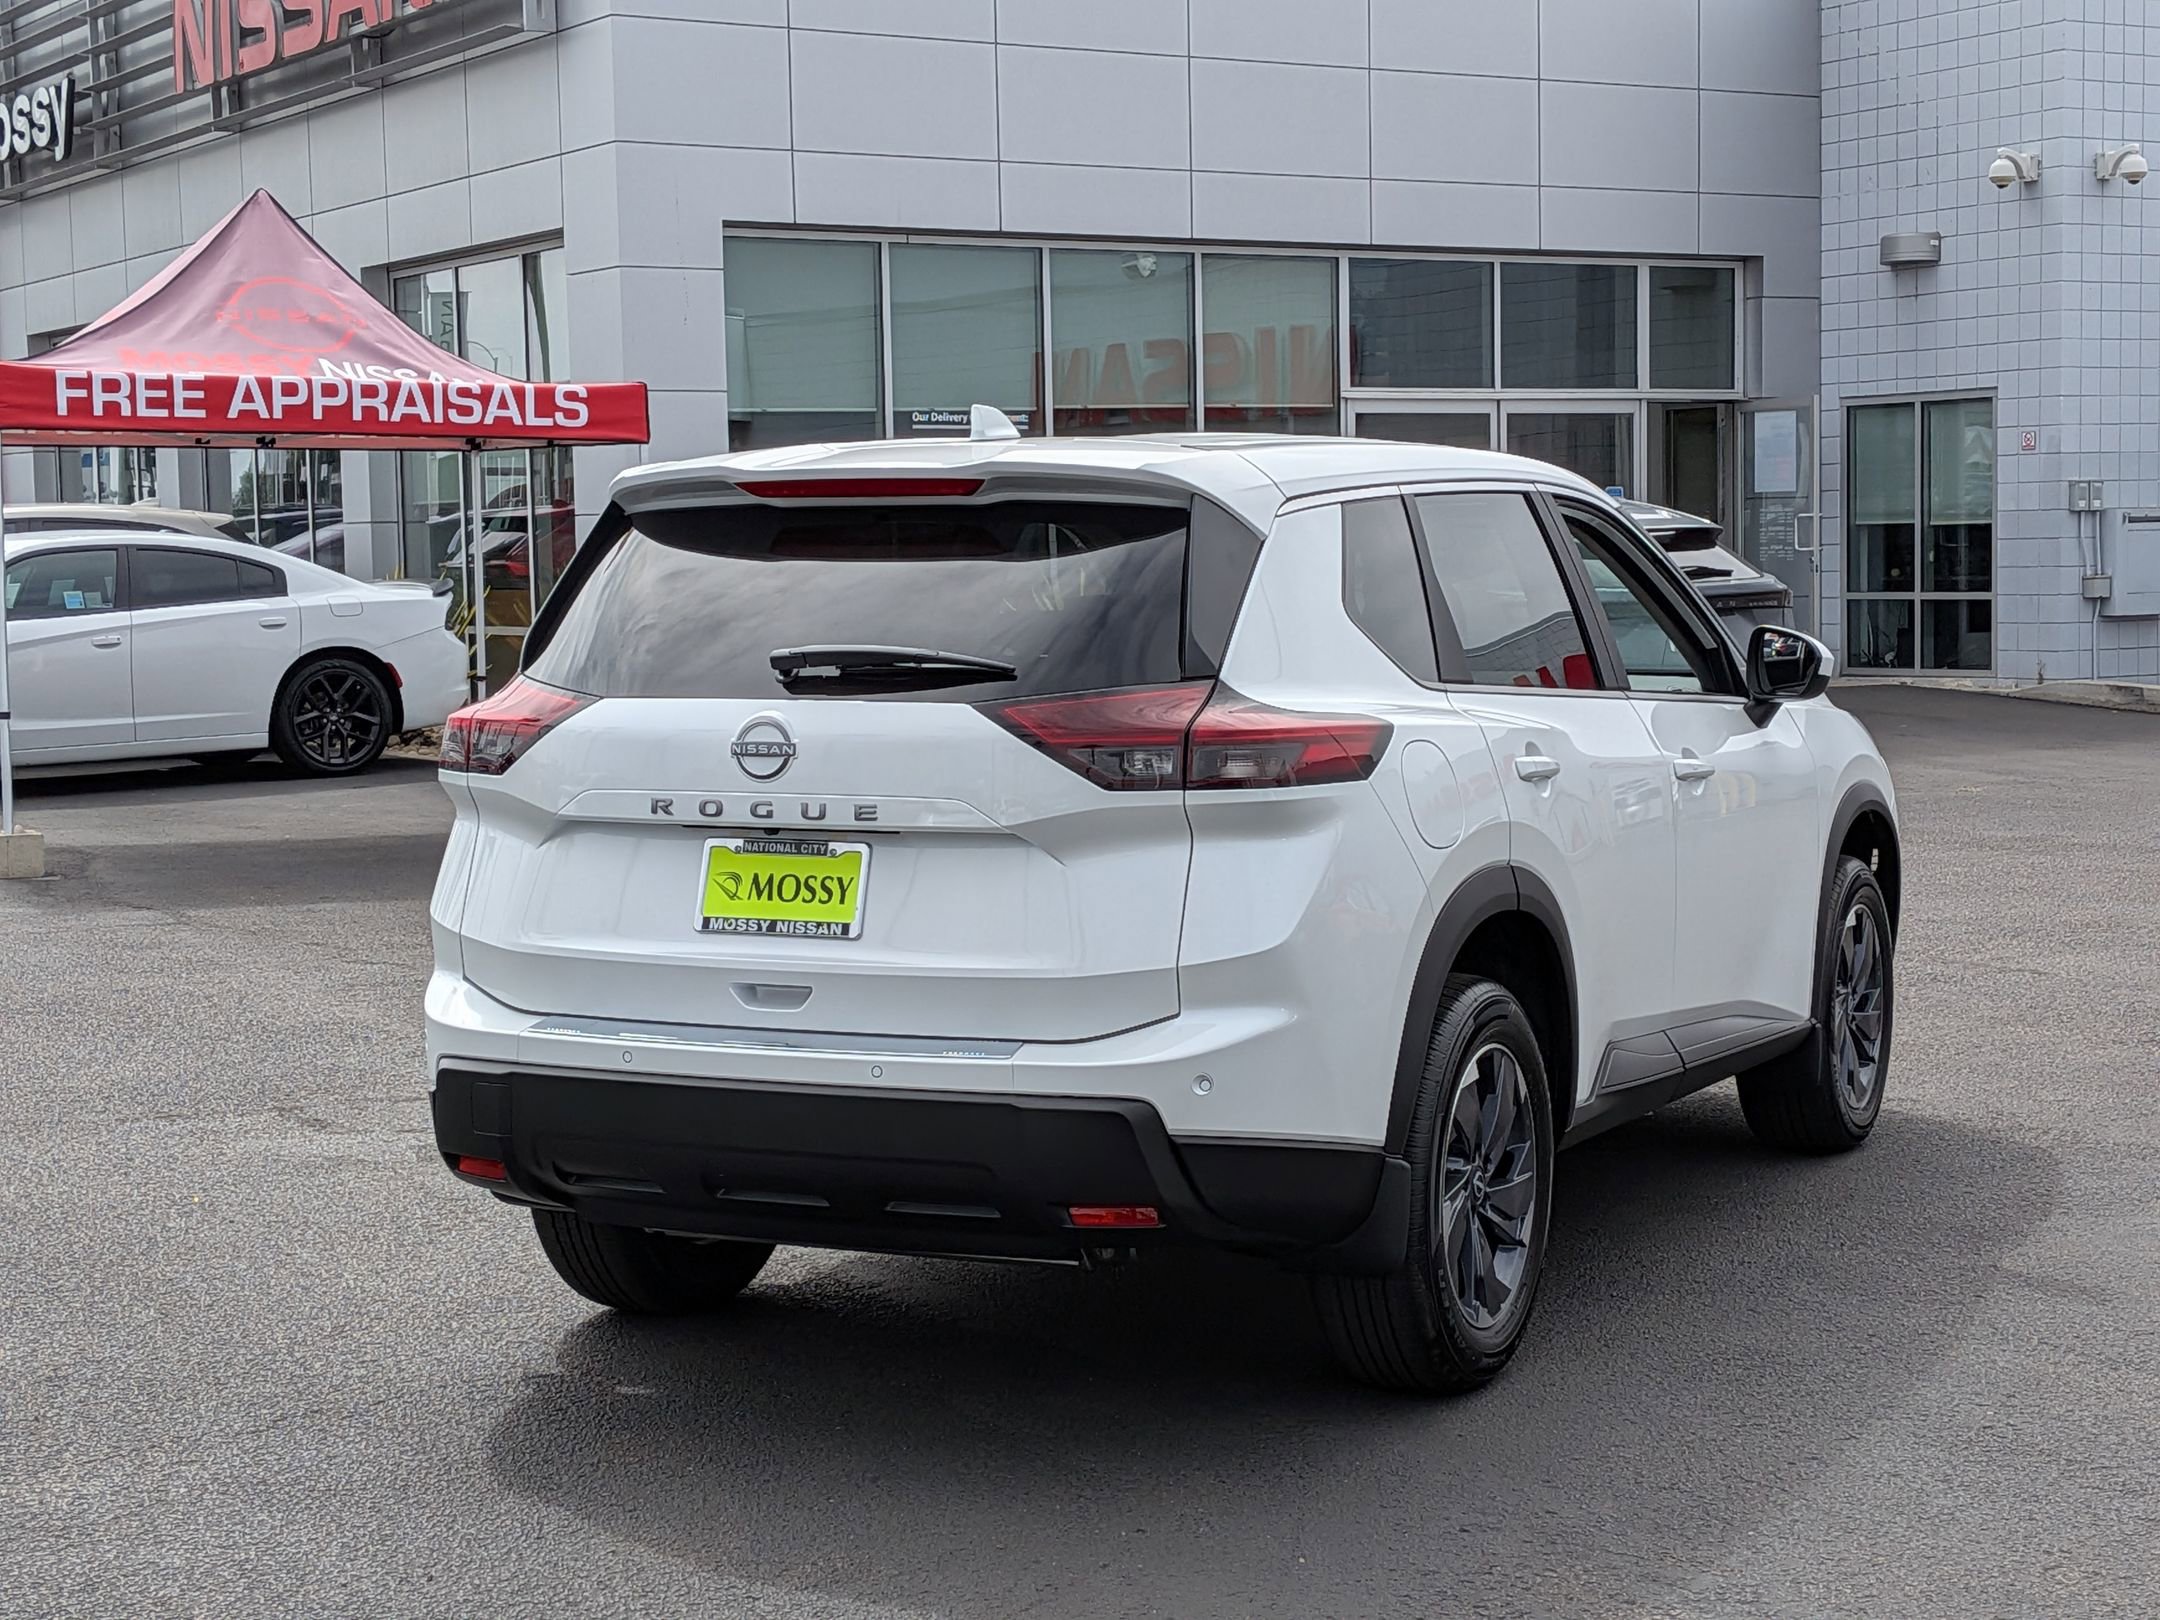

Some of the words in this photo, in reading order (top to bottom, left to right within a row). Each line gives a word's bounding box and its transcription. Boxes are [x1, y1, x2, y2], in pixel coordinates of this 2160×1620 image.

[172, 0, 432, 95] NISSA
[318, 357, 486, 384] NISS
[54, 369, 207, 418] FREE
[226, 375, 589, 428] APPRAISALS
[911, 412, 929, 422] Our
[930, 412, 968, 424] Delivery
[732, 742, 794, 755] NISSAN
[650, 797, 878, 822] ROGUE
[744, 841, 797, 854] NATIONAL
[800, 843, 827, 855] CITY
[747, 872, 854, 905] MOSSY
[709, 917, 771, 932] MOSSY
[776, 920, 842, 936] NISSAN
